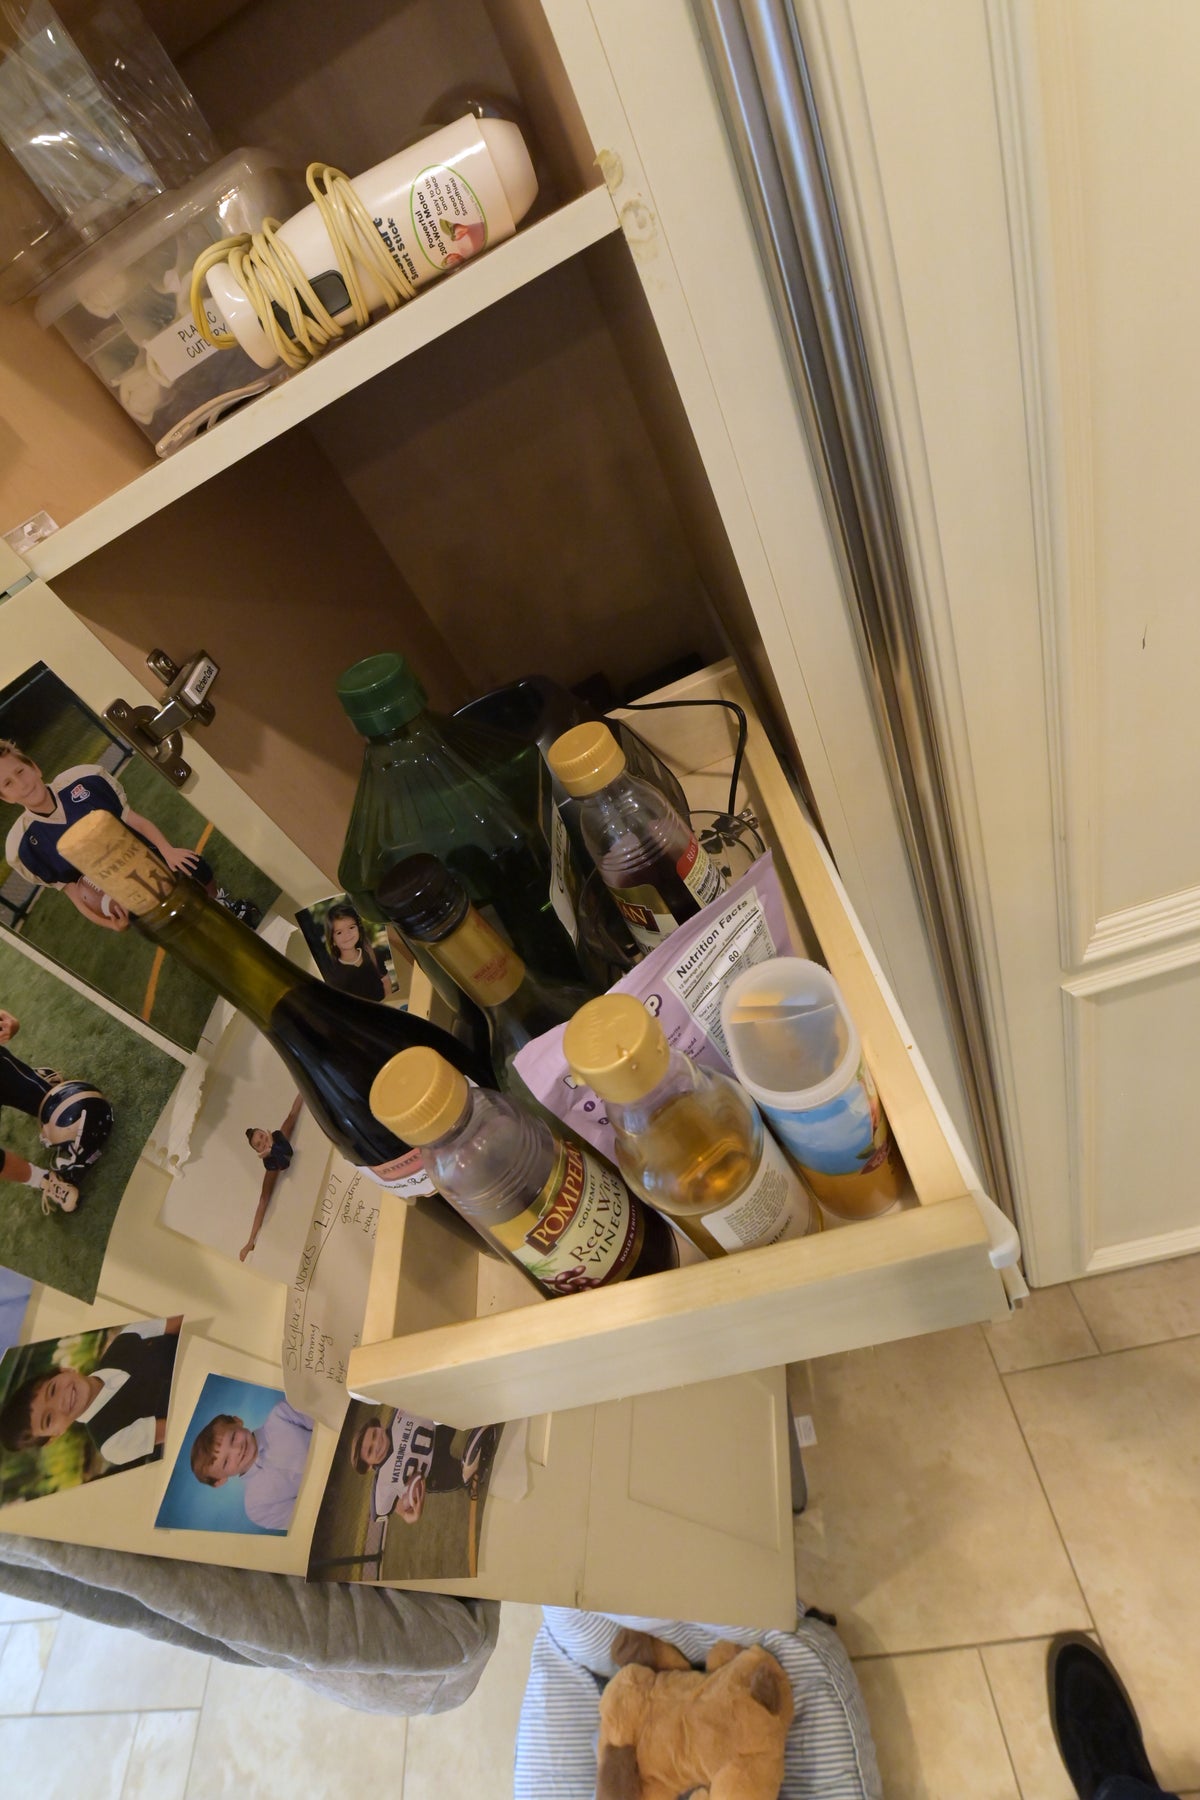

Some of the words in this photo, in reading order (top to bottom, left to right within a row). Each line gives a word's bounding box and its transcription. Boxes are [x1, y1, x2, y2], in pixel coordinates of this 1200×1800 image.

[416, 191, 432, 219] Motor
[429, 190, 435, 198] to
[433, 200, 443, 216] Easy
[438, 196, 448, 211] and
[448, 195, 460, 216] Great
[449, 177, 468, 216] Smoothies!
[387, 218, 406, 252] Stick
[415, 210, 434, 249] Powerful
[428, 218, 448, 256] 200-Watt
[402, 252, 419, 280] Smart
[178, 311, 217, 342] PLAC
[186, 322, 228, 358] CUTLRY
[676, 929, 720, 978] Nutrition
[718, 900, 748, 930] Facts
[728, 950, 740, 963] 60
[578, 1174, 596, 1229] GOURMET
[568, 1218, 606, 1262] Red
[588, 1180, 622, 1263] VINEGAR
[294, 1244, 316, 1292] Words
[620, 1239, 632, 1262] BOLD
[305, 1324, 320, 1369] Mommy
[315, 1334, 334, 1374] Daddy
[391, 1444, 407, 1483] WATCHUNG
[401, 1421, 414, 1444] HILLS
[402, 1426, 434, 1487] 20
